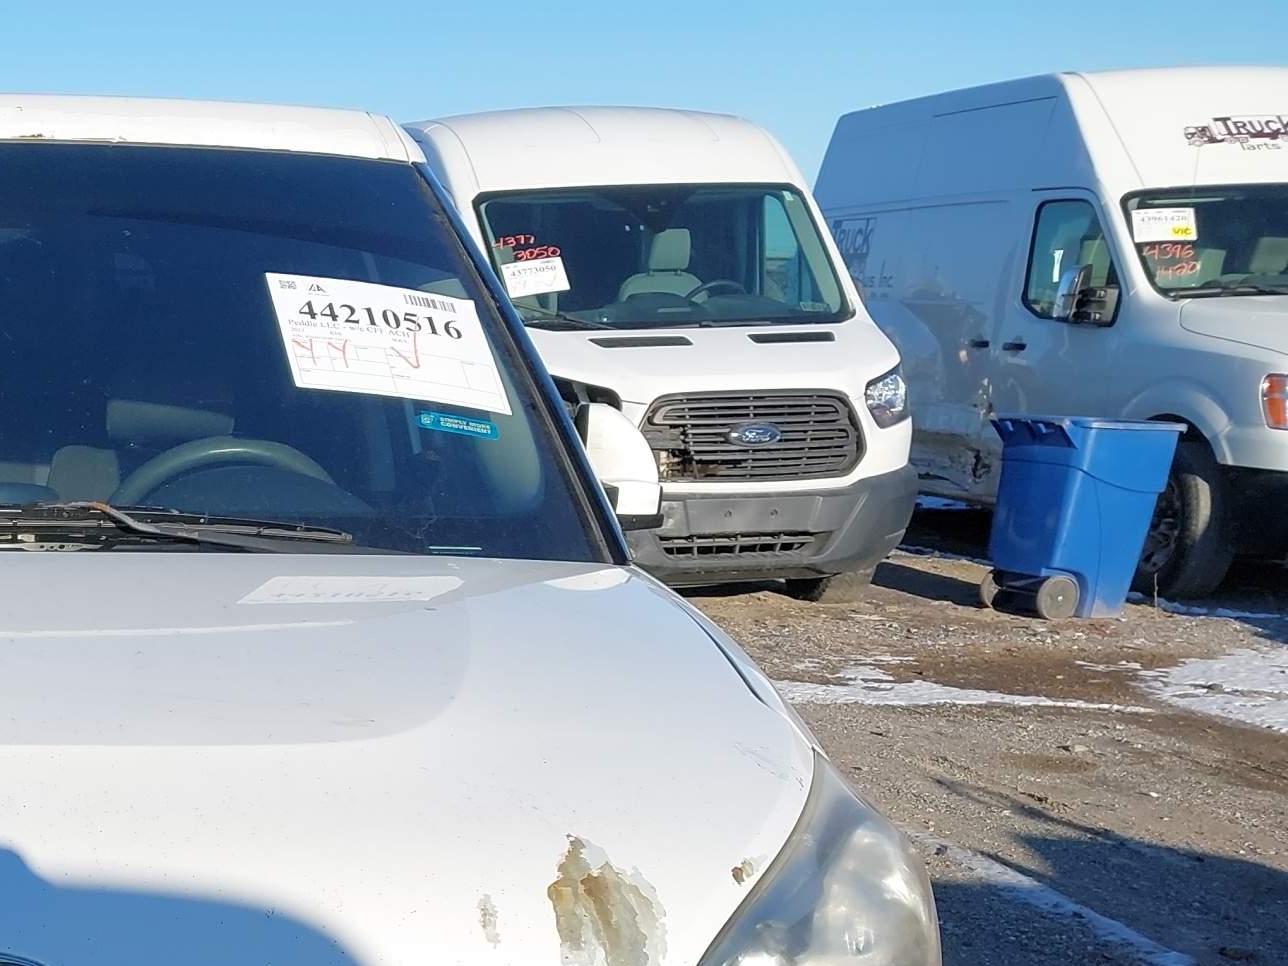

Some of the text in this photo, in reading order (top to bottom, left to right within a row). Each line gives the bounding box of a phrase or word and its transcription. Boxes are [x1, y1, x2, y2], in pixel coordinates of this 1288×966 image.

[491, 234, 535, 250] 4377
[512, 246, 561, 261] 3050
[1142, 244, 1194, 260] 4396
[298, 300, 463, 340] 44210516
[741, 429, 771, 442] Ford
